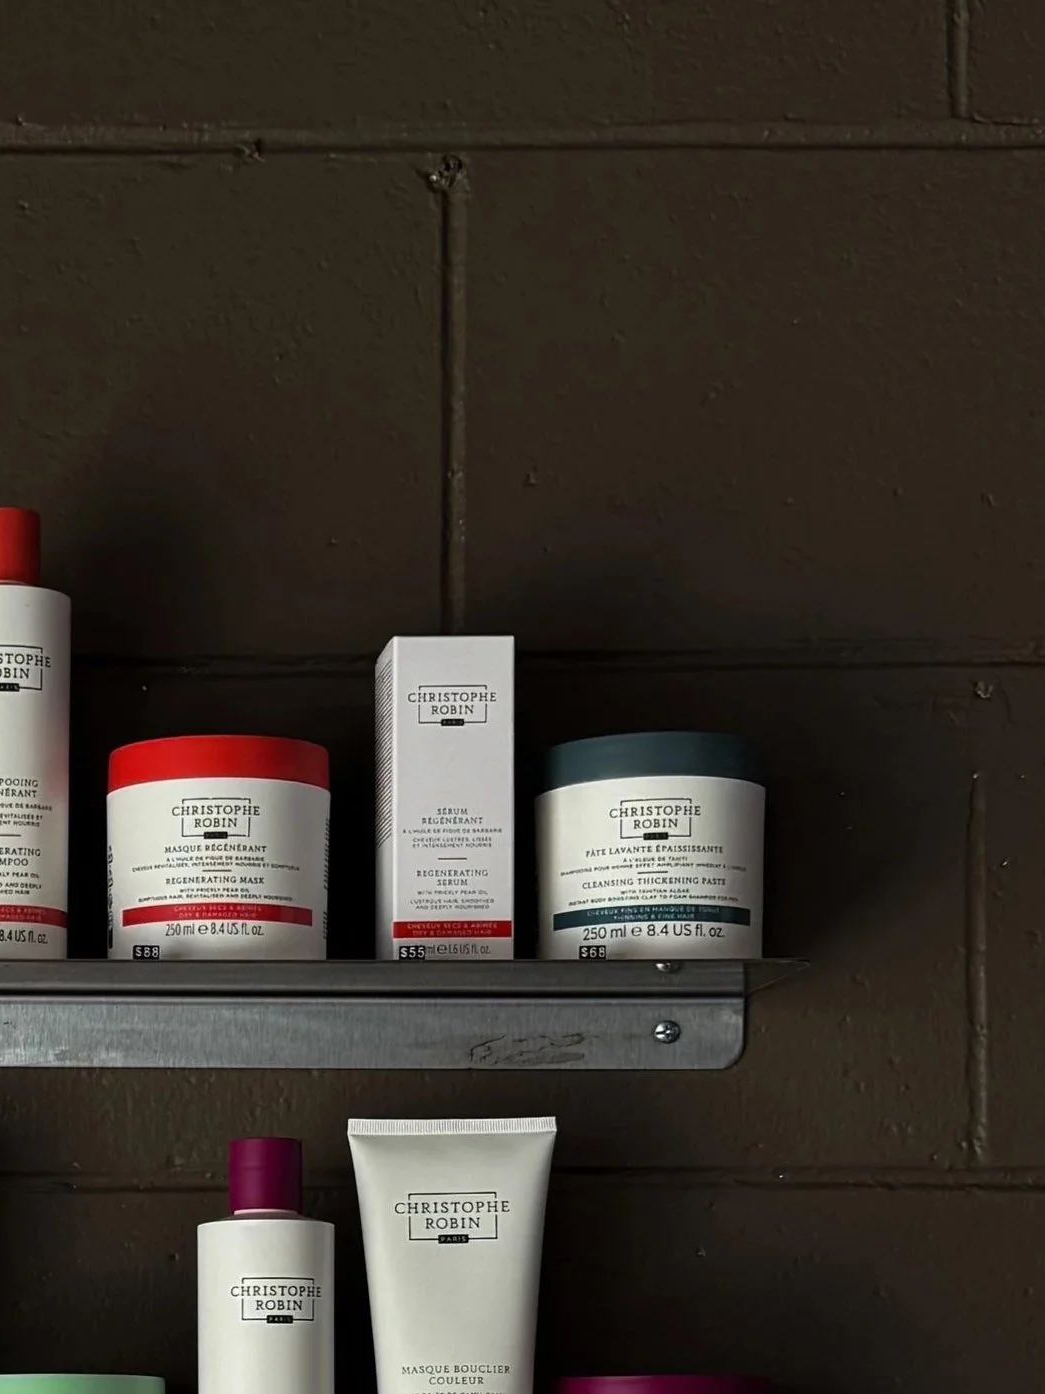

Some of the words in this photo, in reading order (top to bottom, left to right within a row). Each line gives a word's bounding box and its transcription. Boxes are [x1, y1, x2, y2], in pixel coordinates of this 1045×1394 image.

[408, 692, 497, 703] CHRISTOPHE
[431, 705, 474, 715] ROBIN
[172, 806, 260, 817] CHRISTOPHE
[609, 806, 701, 818] CHRISTOPHE
[194, 818, 237, 828] ROBIN
[634, 819, 678, 829] ROBIN
[165, 845, 202, 853] MASQUE
[583, 927, 607, 941] 250
[610, 925, 626, 938] ml
[647, 924, 669, 936] 8.4
[673, 924, 692, 936] US
[695, 924, 705, 936] fl.
[401, 947, 425, 958] $55
[581, 947, 605, 958] $68
[394, 1201, 510, 1214] CHRISTOPHE
[425, 1217, 481, 1229] ROBIN
[230, 1286, 322, 1298] CHRISTOPHE
[255, 1300, 303, 1312] ROBIN
[402, 1365, 450, 1375] MASQUE
[454, 1365, 510, 1373] BOUCLIER
[429, 1376, 483, 1385] COULEUR
